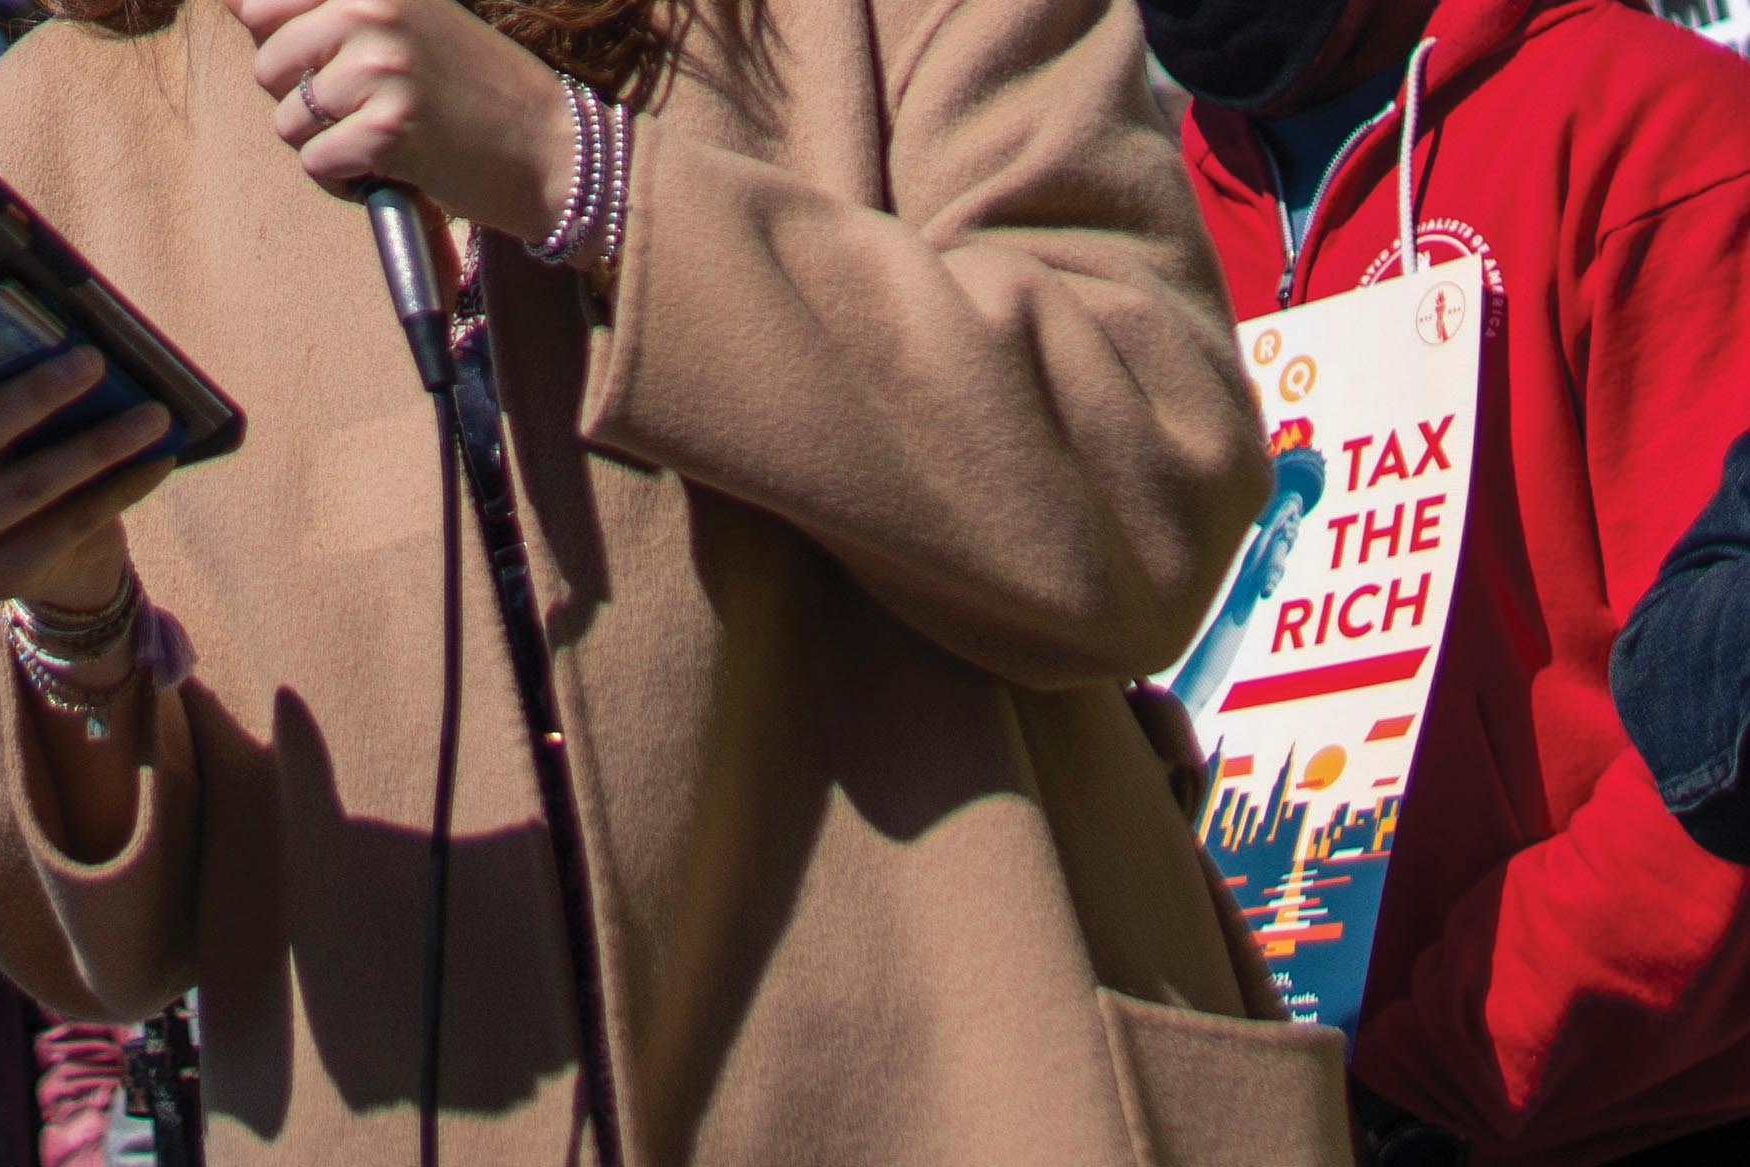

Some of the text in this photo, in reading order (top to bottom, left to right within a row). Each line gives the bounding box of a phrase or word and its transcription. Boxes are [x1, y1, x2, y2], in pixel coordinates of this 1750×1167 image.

[1342, 414, 1456, 492] TAX
[1327, 494, 1447, 570] THE
[1271, 572, 1432, 653] RICH
